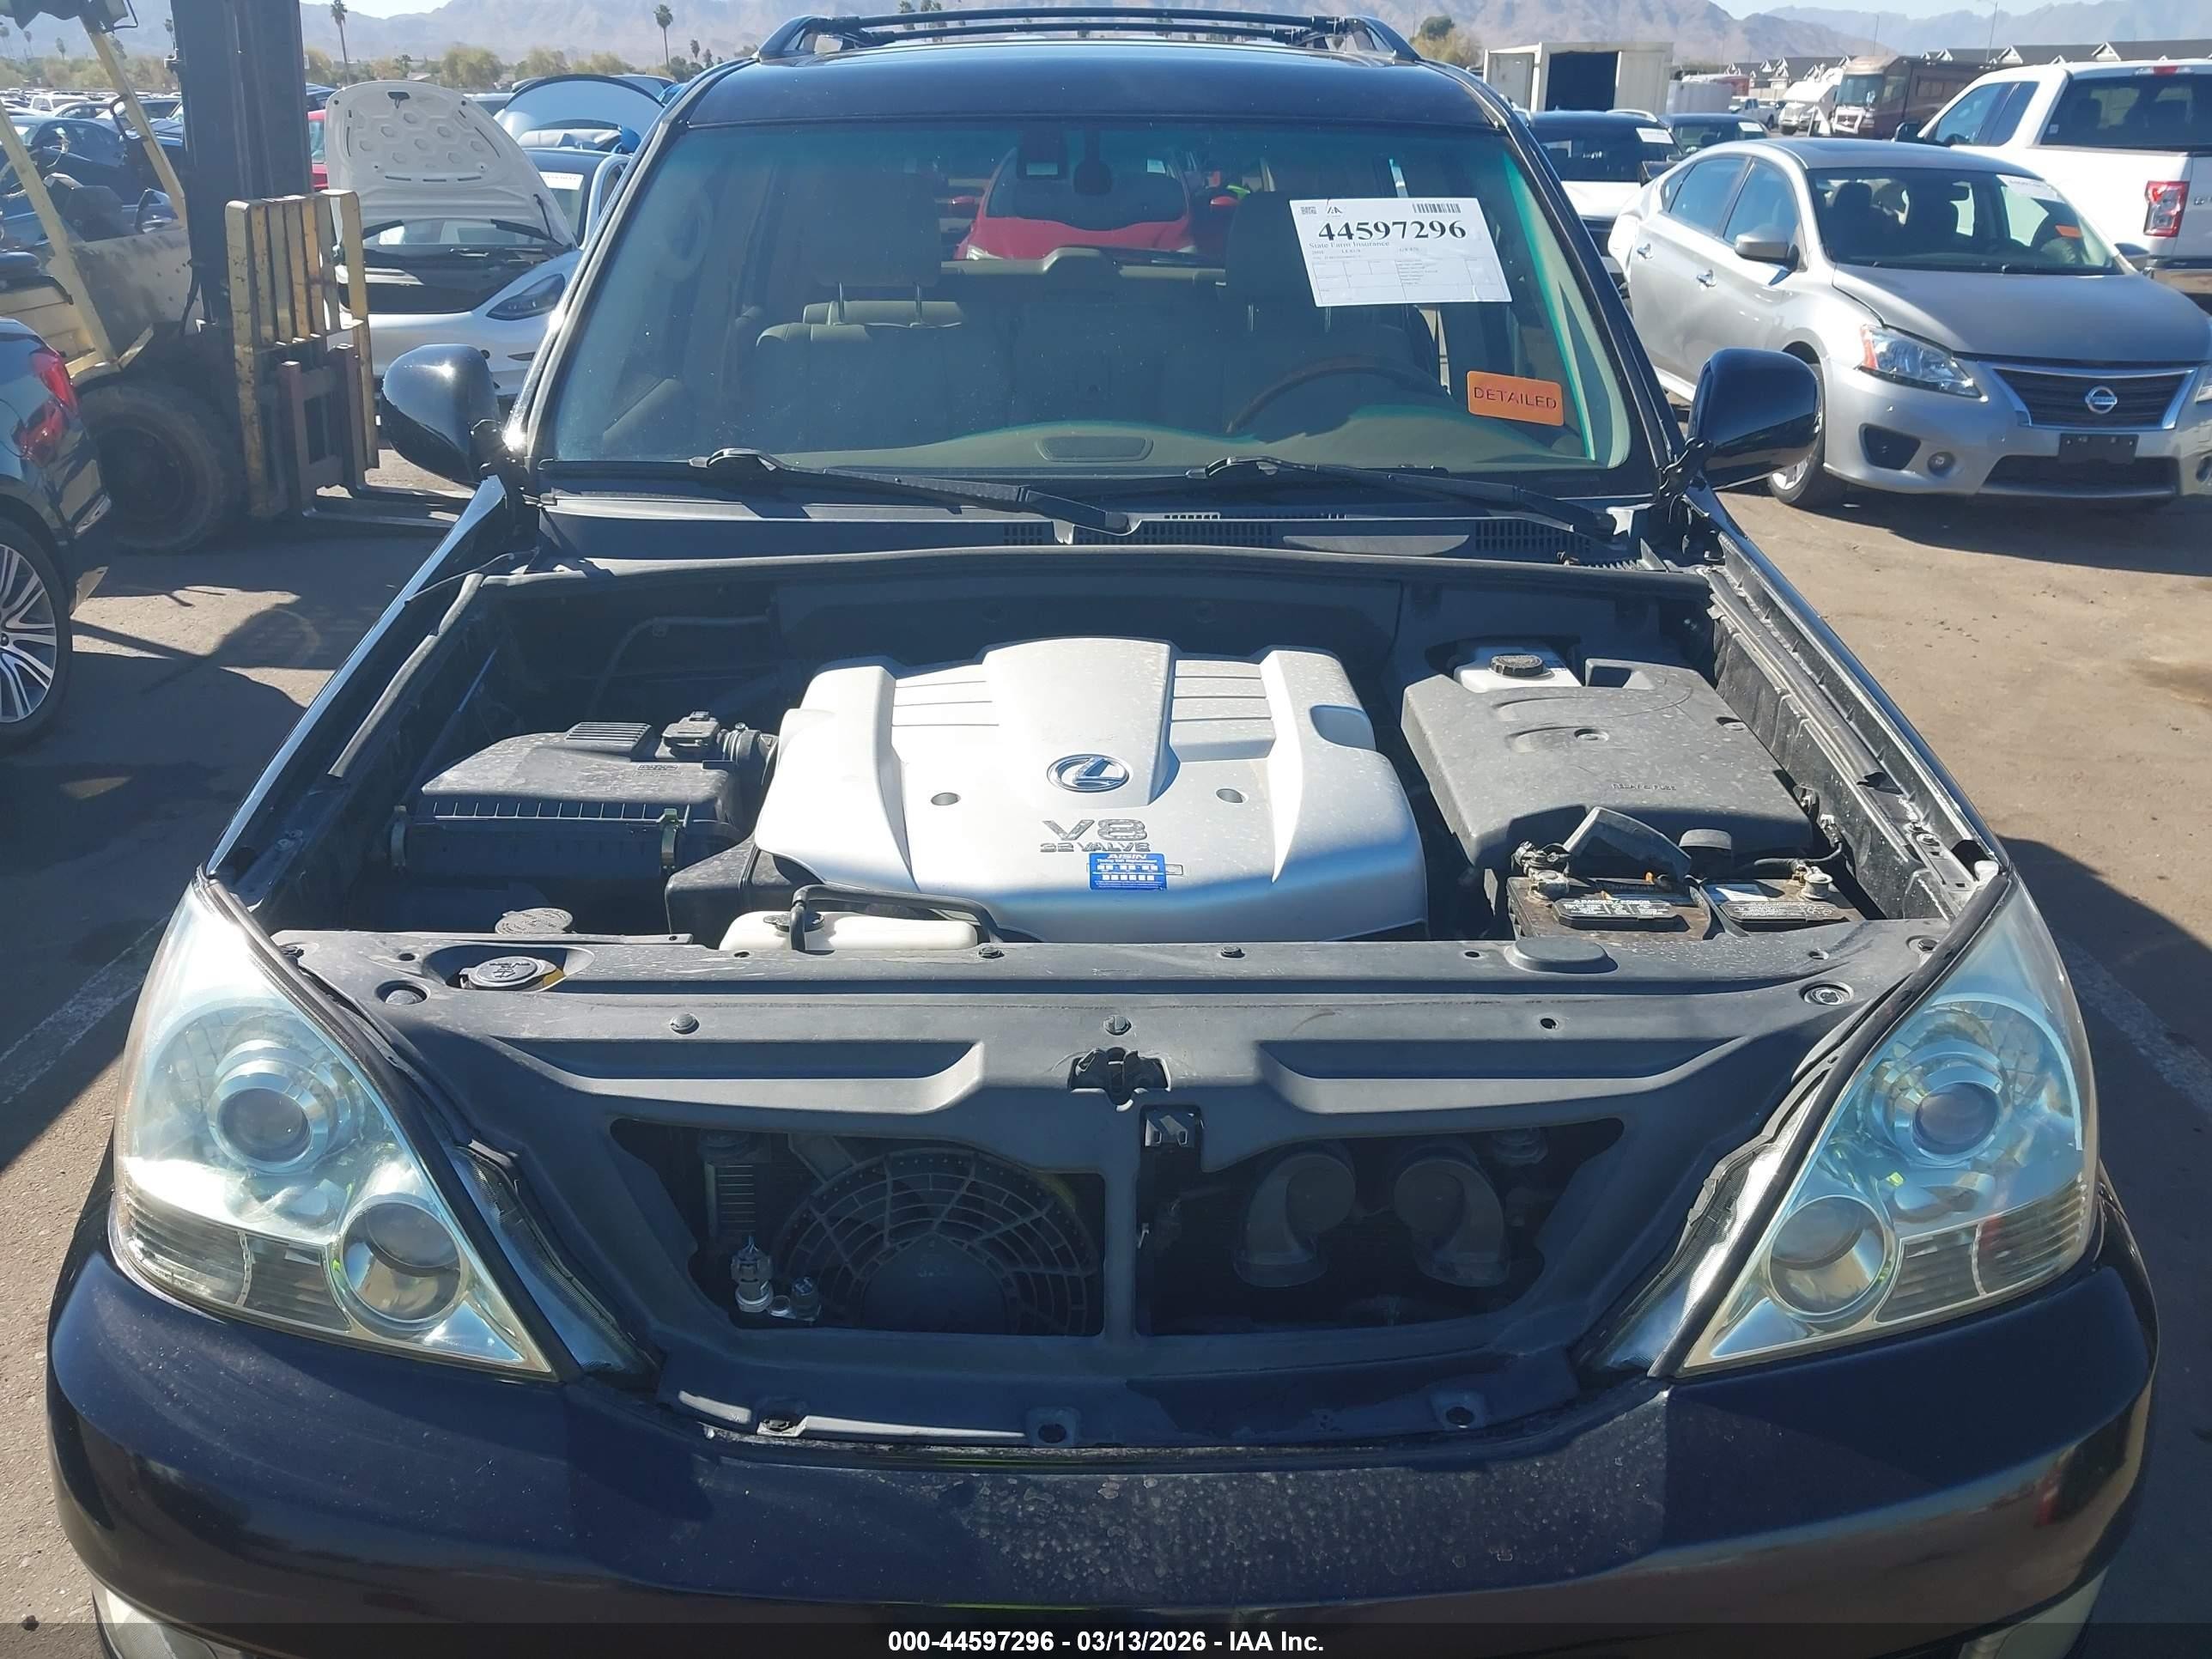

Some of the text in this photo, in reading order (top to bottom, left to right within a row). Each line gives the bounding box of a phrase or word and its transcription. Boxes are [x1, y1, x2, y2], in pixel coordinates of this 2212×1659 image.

[1318, 220, 1467, 241] 44597296
[1474, 386, 1557, 410] DETAILED
[1042, 818, 1147, 842] V8
